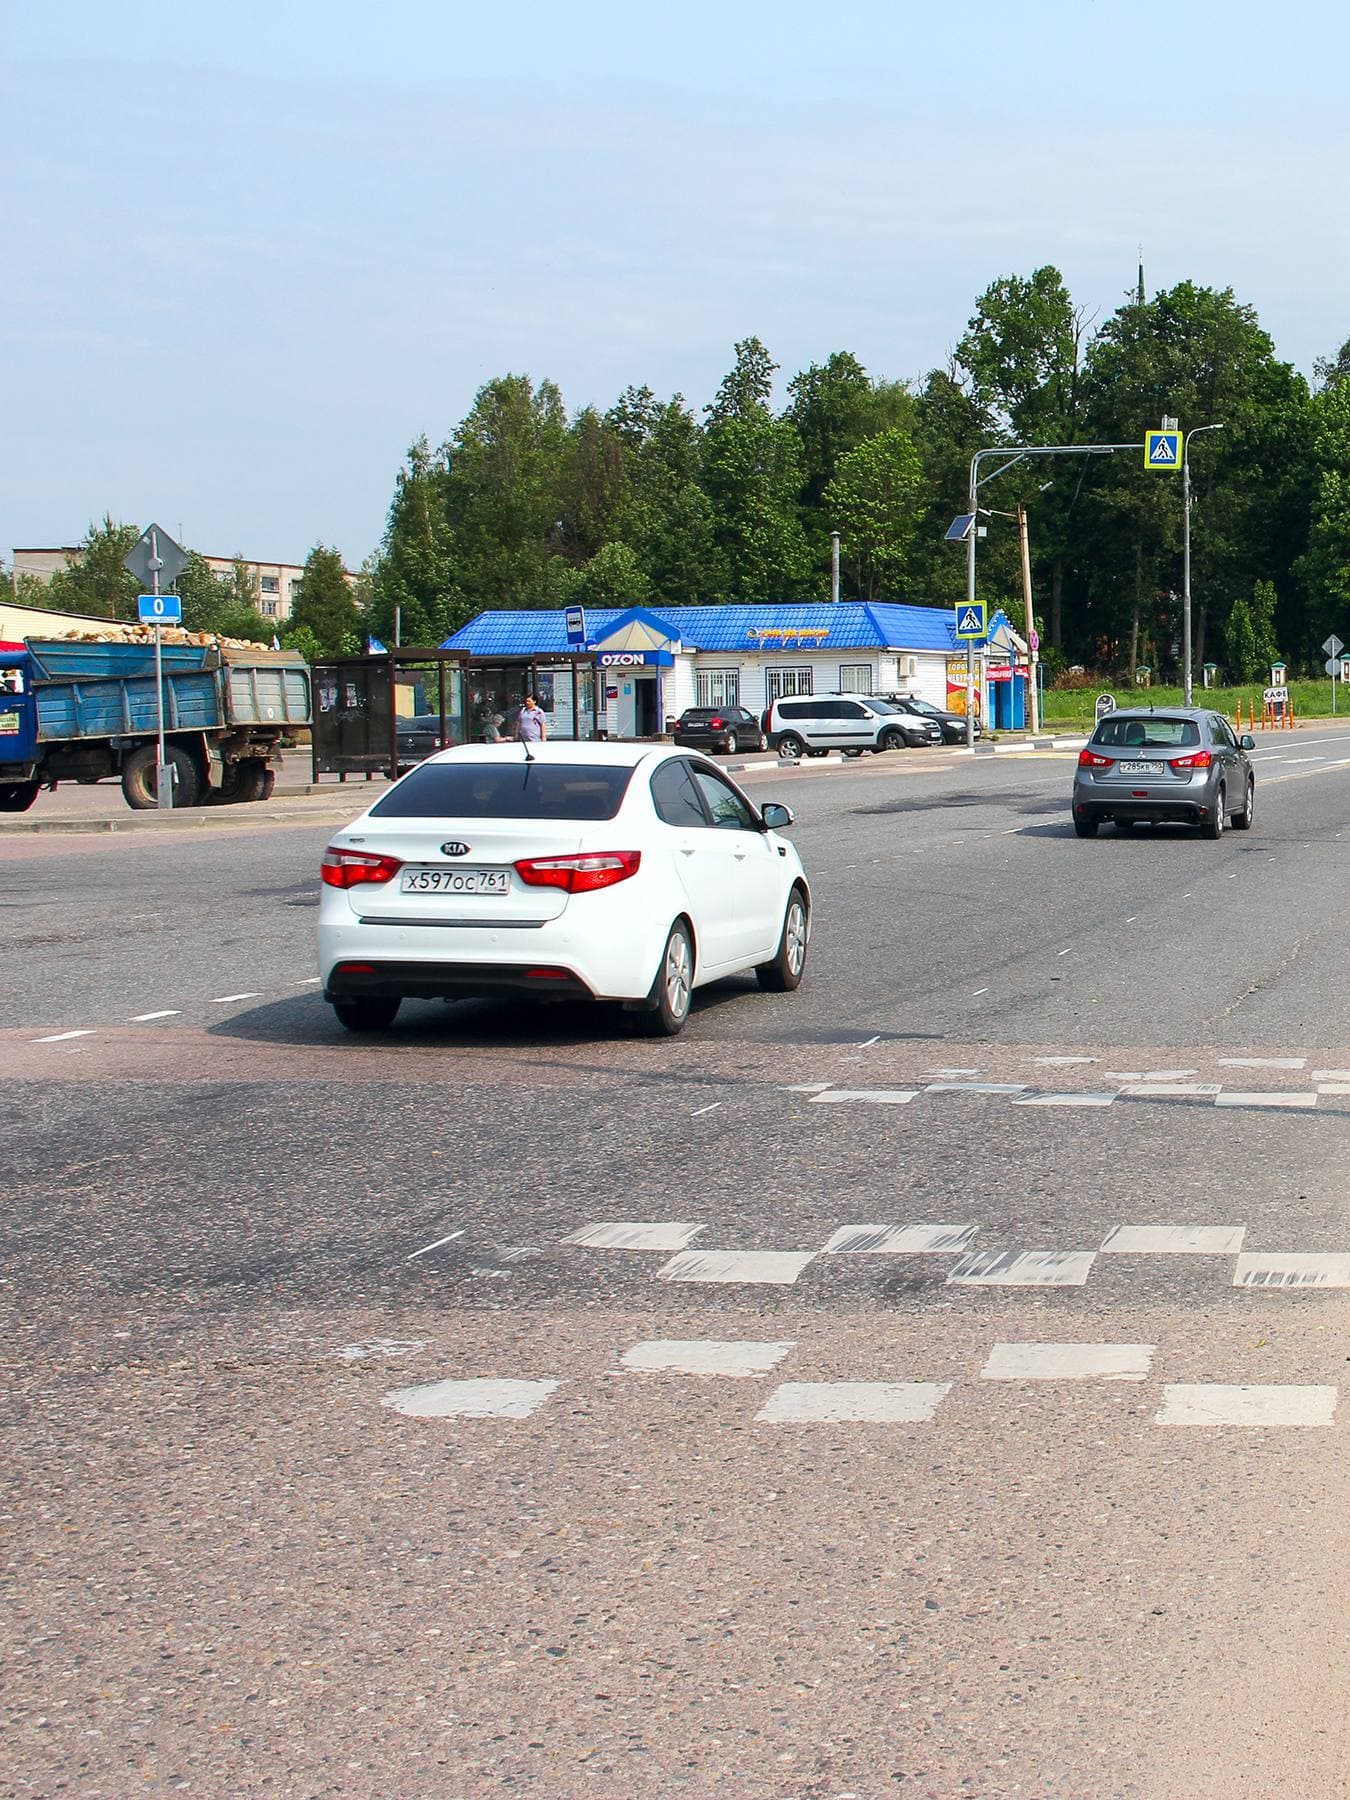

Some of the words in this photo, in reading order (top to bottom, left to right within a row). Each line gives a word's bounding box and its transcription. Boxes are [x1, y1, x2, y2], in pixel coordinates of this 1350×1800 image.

[154, 598, 164, 615] 0
[601, 653, 645, 666] OZON
[1264, 690, 1286, 699] КАФЕ
[444, 844, 466, 853] KIA
[408, 872, 475, 890] Х597ОС
[479, 872, 506, 886] 761
